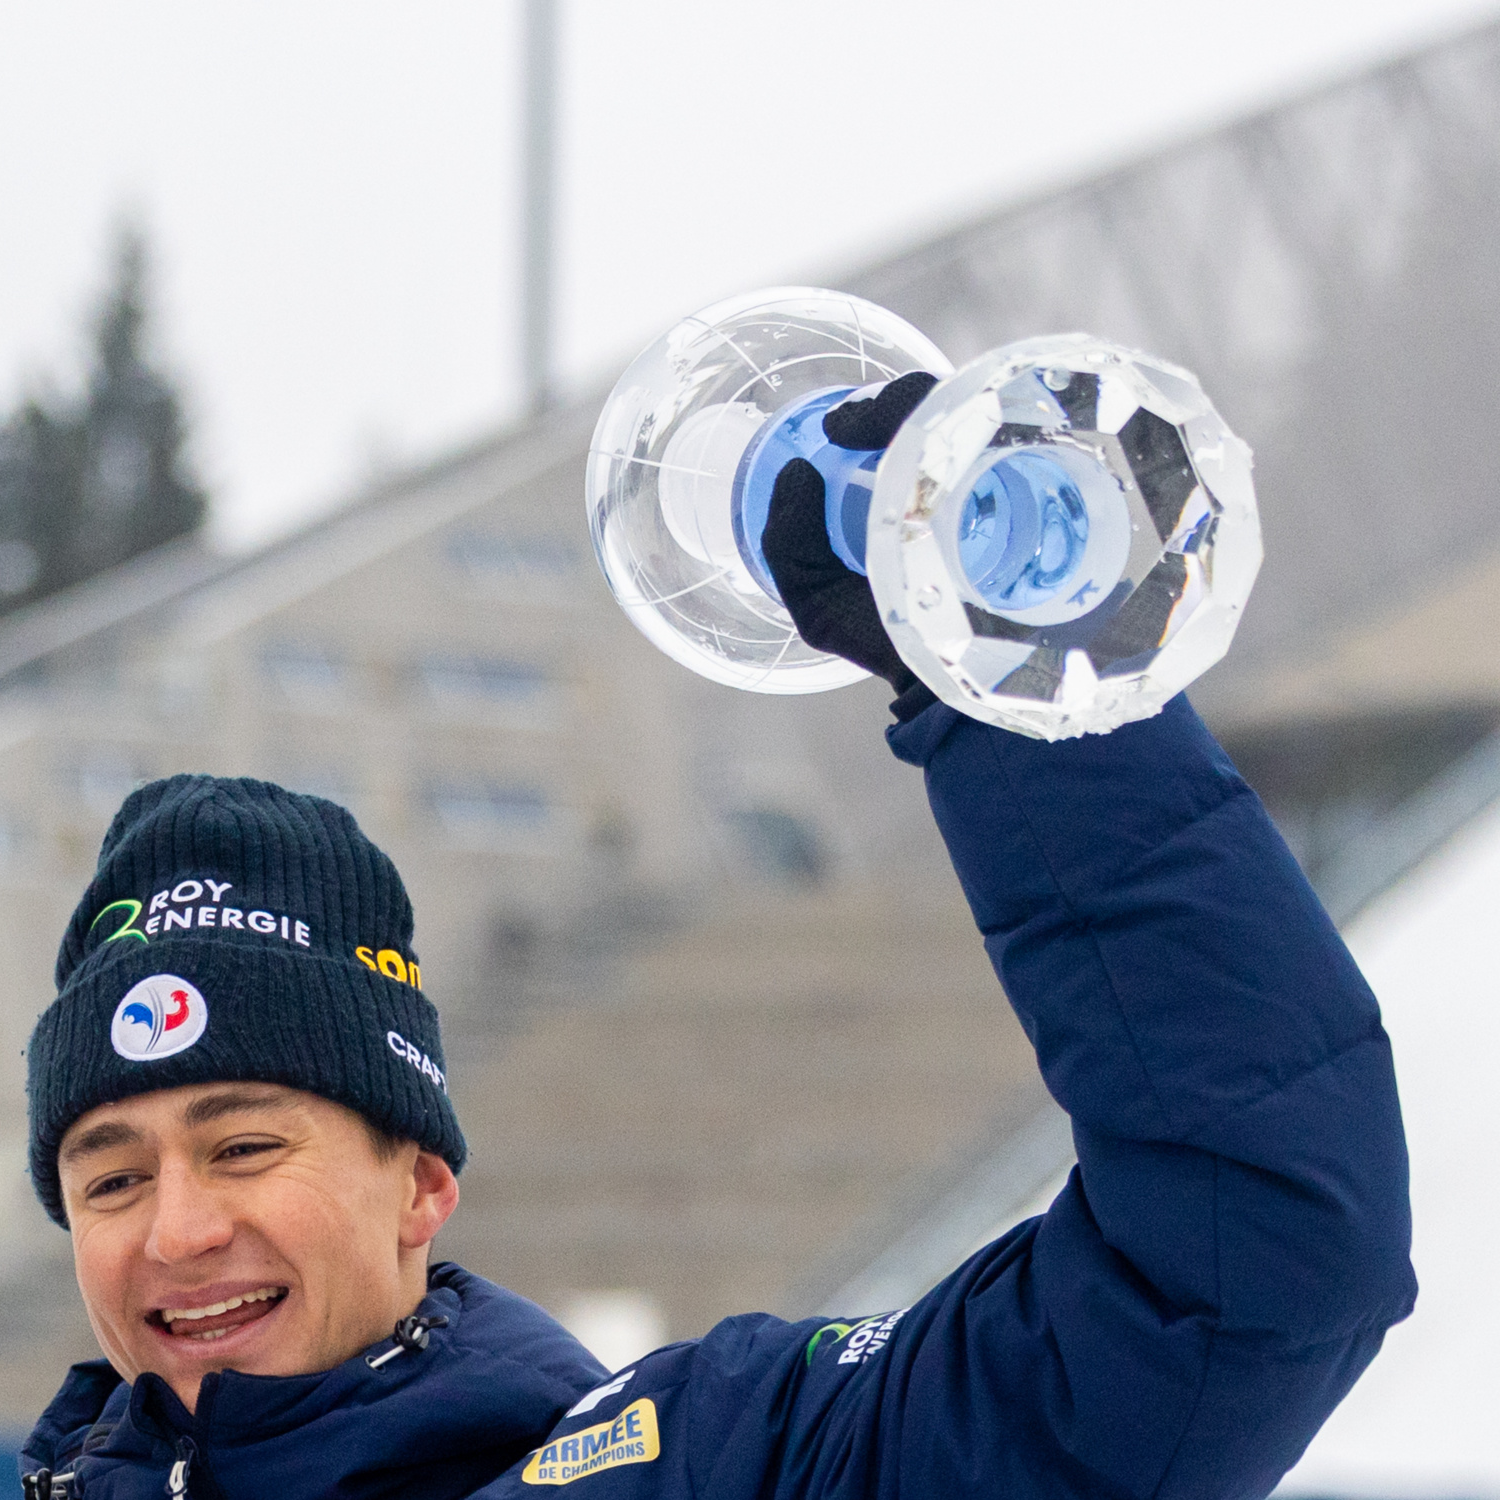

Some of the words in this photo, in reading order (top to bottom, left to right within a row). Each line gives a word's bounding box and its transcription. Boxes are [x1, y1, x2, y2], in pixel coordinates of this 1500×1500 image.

[148, 879, 233, 914] ROY
[144, 907, 311, 947] ENERGIE
[538, 1409, 643, 1466] ARMÉE
[538, 1466, 557, 1480] DE
[562, 1441, 646, 1480] CHAMPIONS
